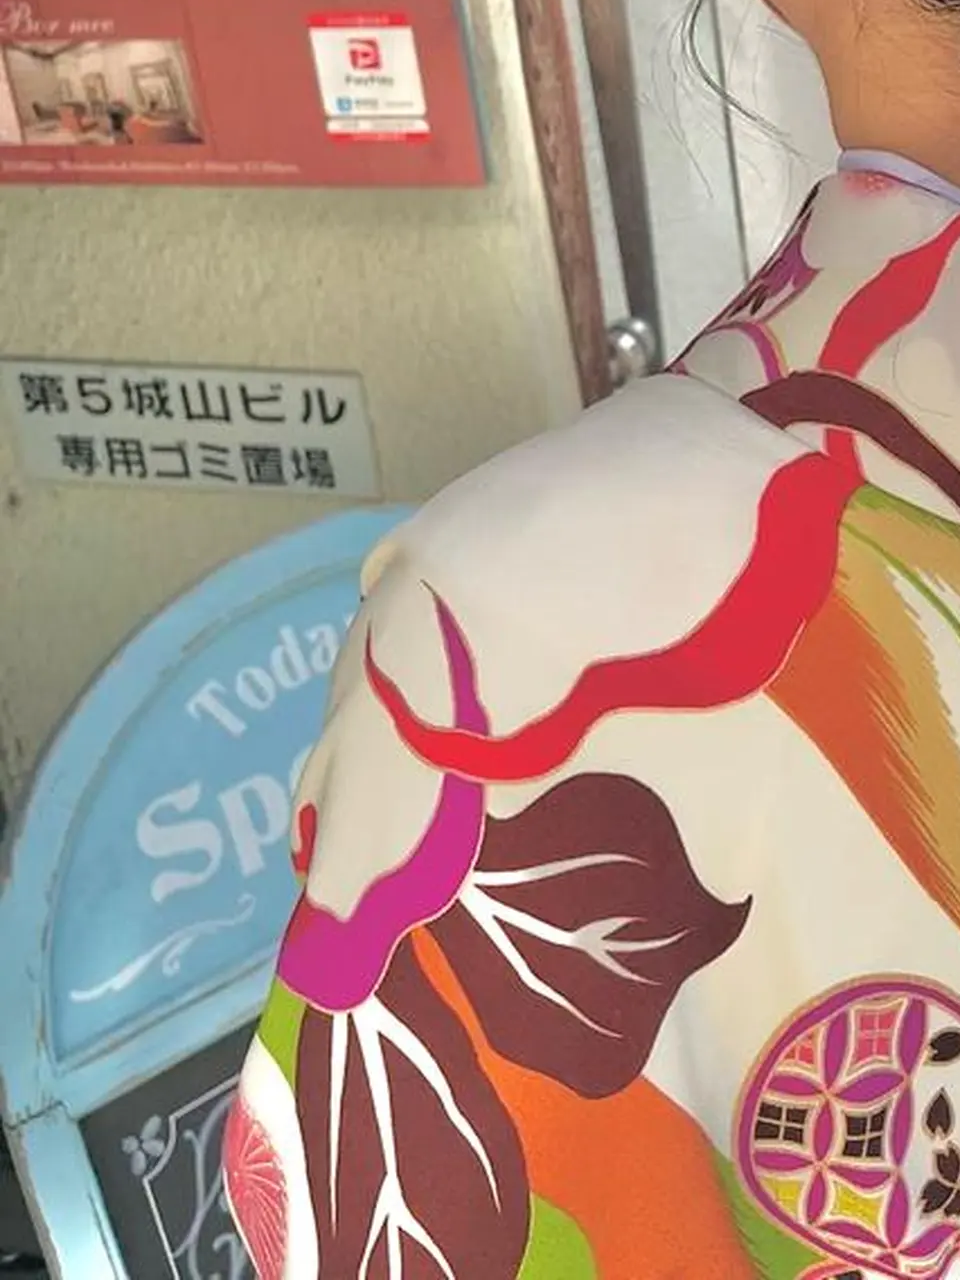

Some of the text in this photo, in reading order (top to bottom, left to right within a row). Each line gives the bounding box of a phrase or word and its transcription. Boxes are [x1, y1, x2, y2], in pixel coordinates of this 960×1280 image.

[56, 433, 337, 489] 専用ゴミ置場
[185, 613, 357, 738] Toda
[136, 745, 313, 904] Sp
